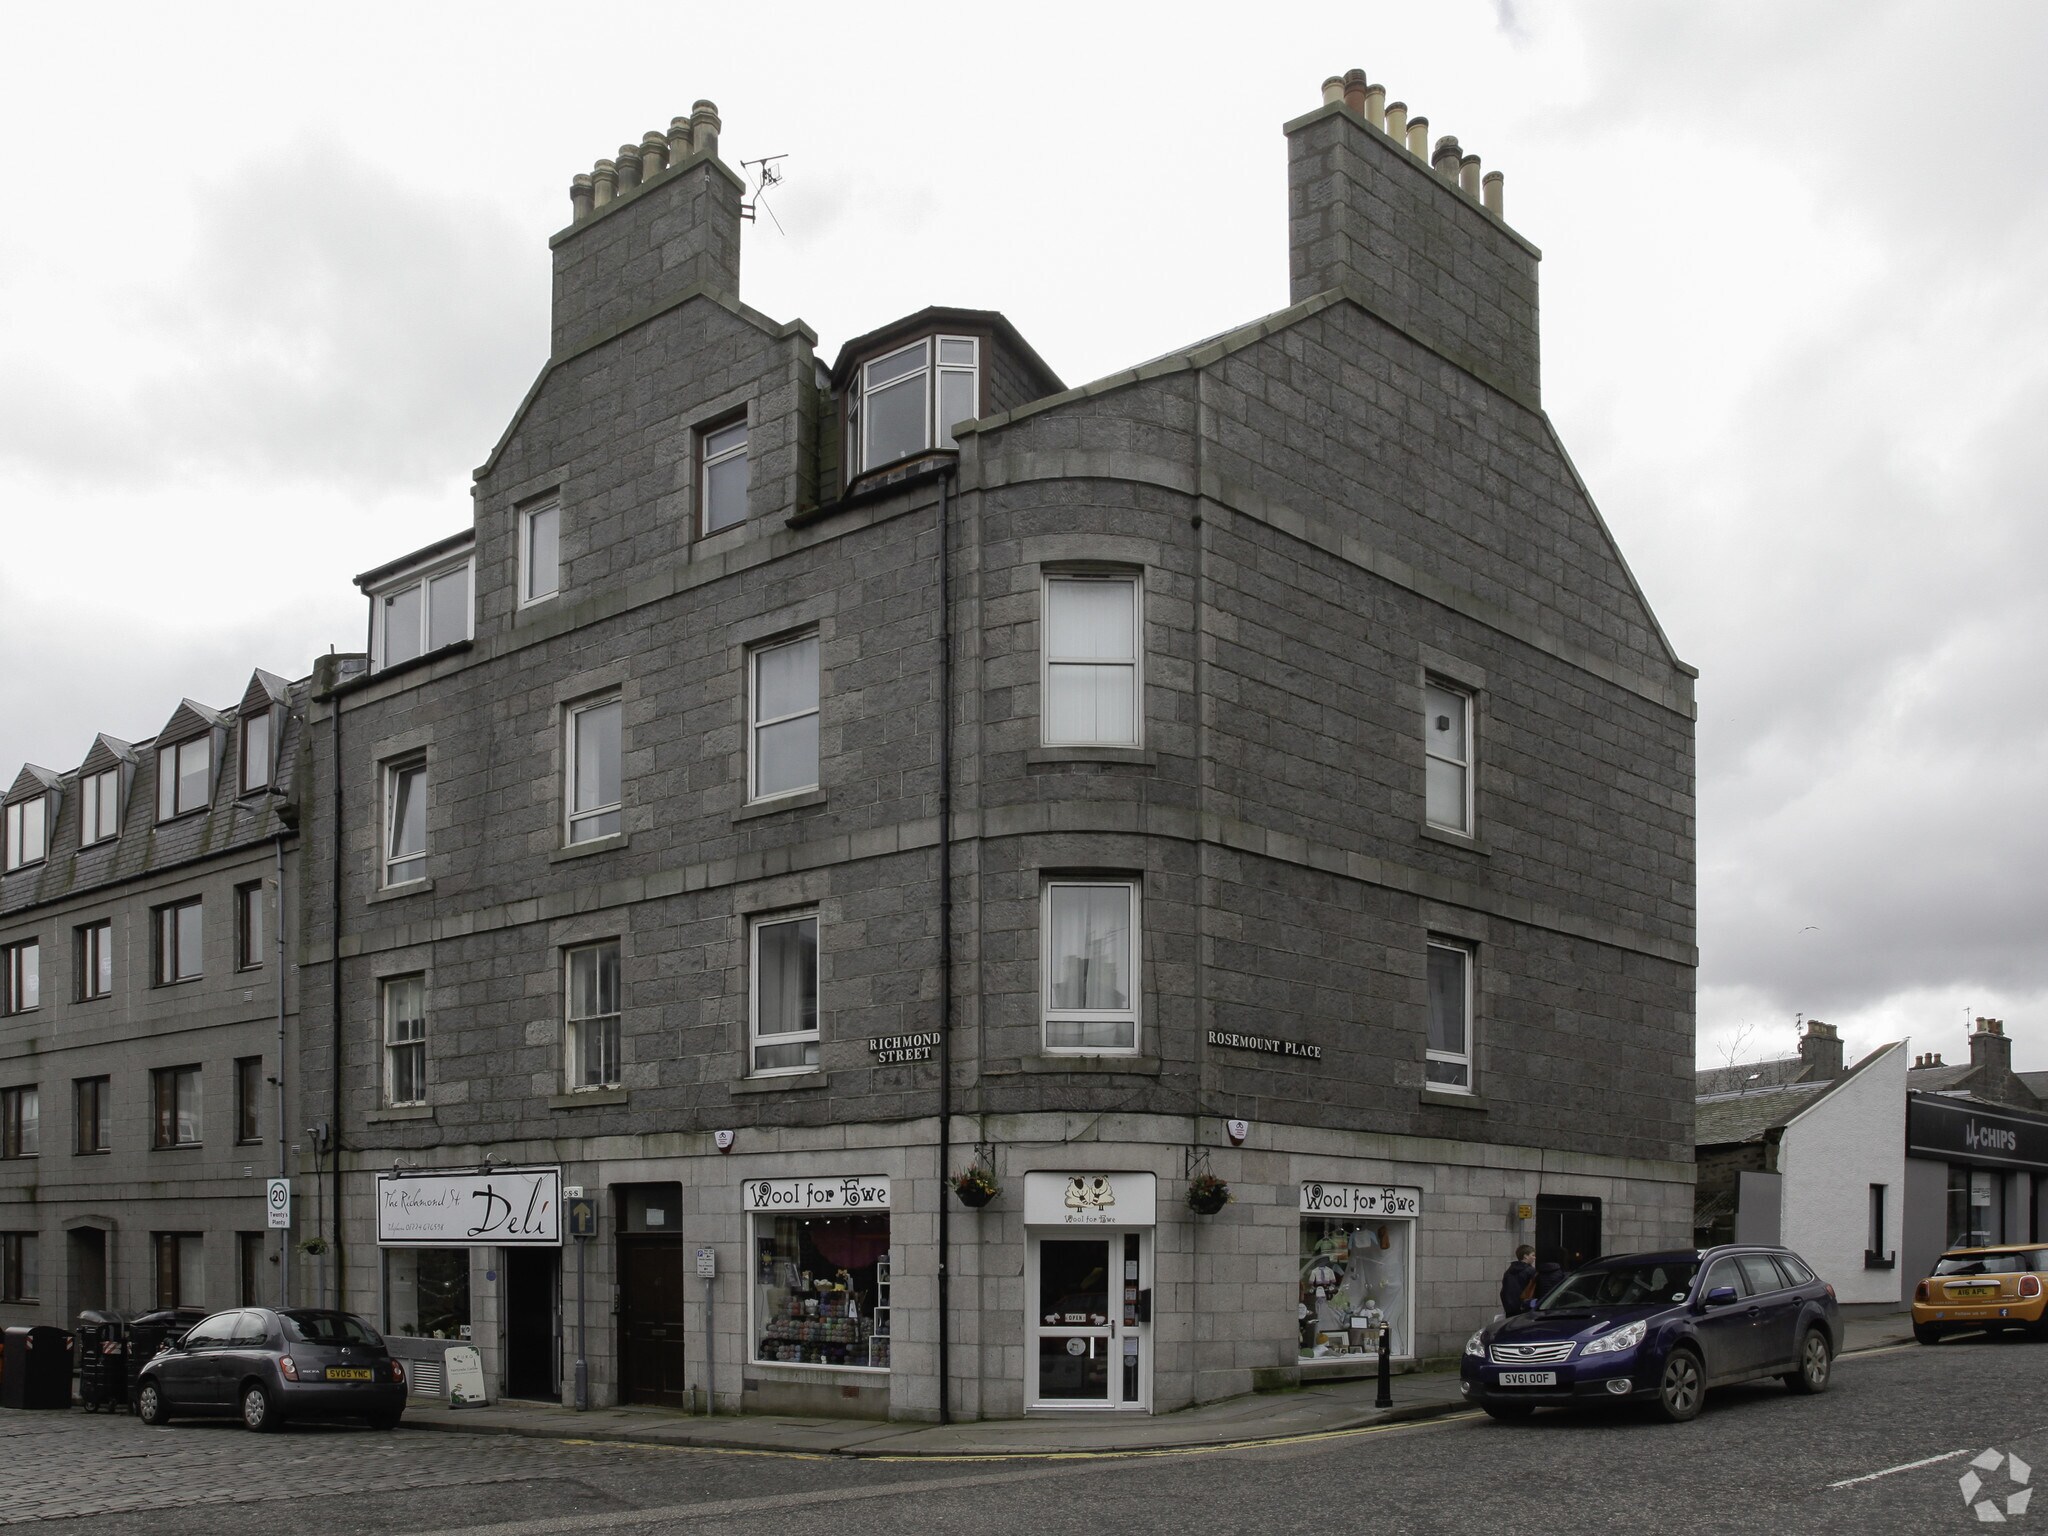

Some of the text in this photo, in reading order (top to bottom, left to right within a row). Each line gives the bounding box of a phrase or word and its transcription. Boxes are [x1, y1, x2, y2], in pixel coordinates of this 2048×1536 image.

[869, 1032, 941, 1051] RICHMOND
[1208, 1030, 1322, 1058] ROSEMOUNT PLACE
[878, 1046, 931, 1063] STREET
[1980, 1126, 2017, 1151] CHIPS
[272, 1190, 285, 1202] 20
[750, 1178, 886, 1207] Wool for Ewe
[1303, 1184, 1415, 1214] Wool for Ewe
[384, 1189, 398, 1209] The
[400, 1185, 447, 1216] Richmond
[467, 1177, 549, 1237] Deli
[1064, 1214, 1084, 1223] Wool
[1086, 1214, 1097, 1223] for
[329, 1370, 369, 1378] SV05 YNC
[1505, 1374, 1527, 1384] SV61
